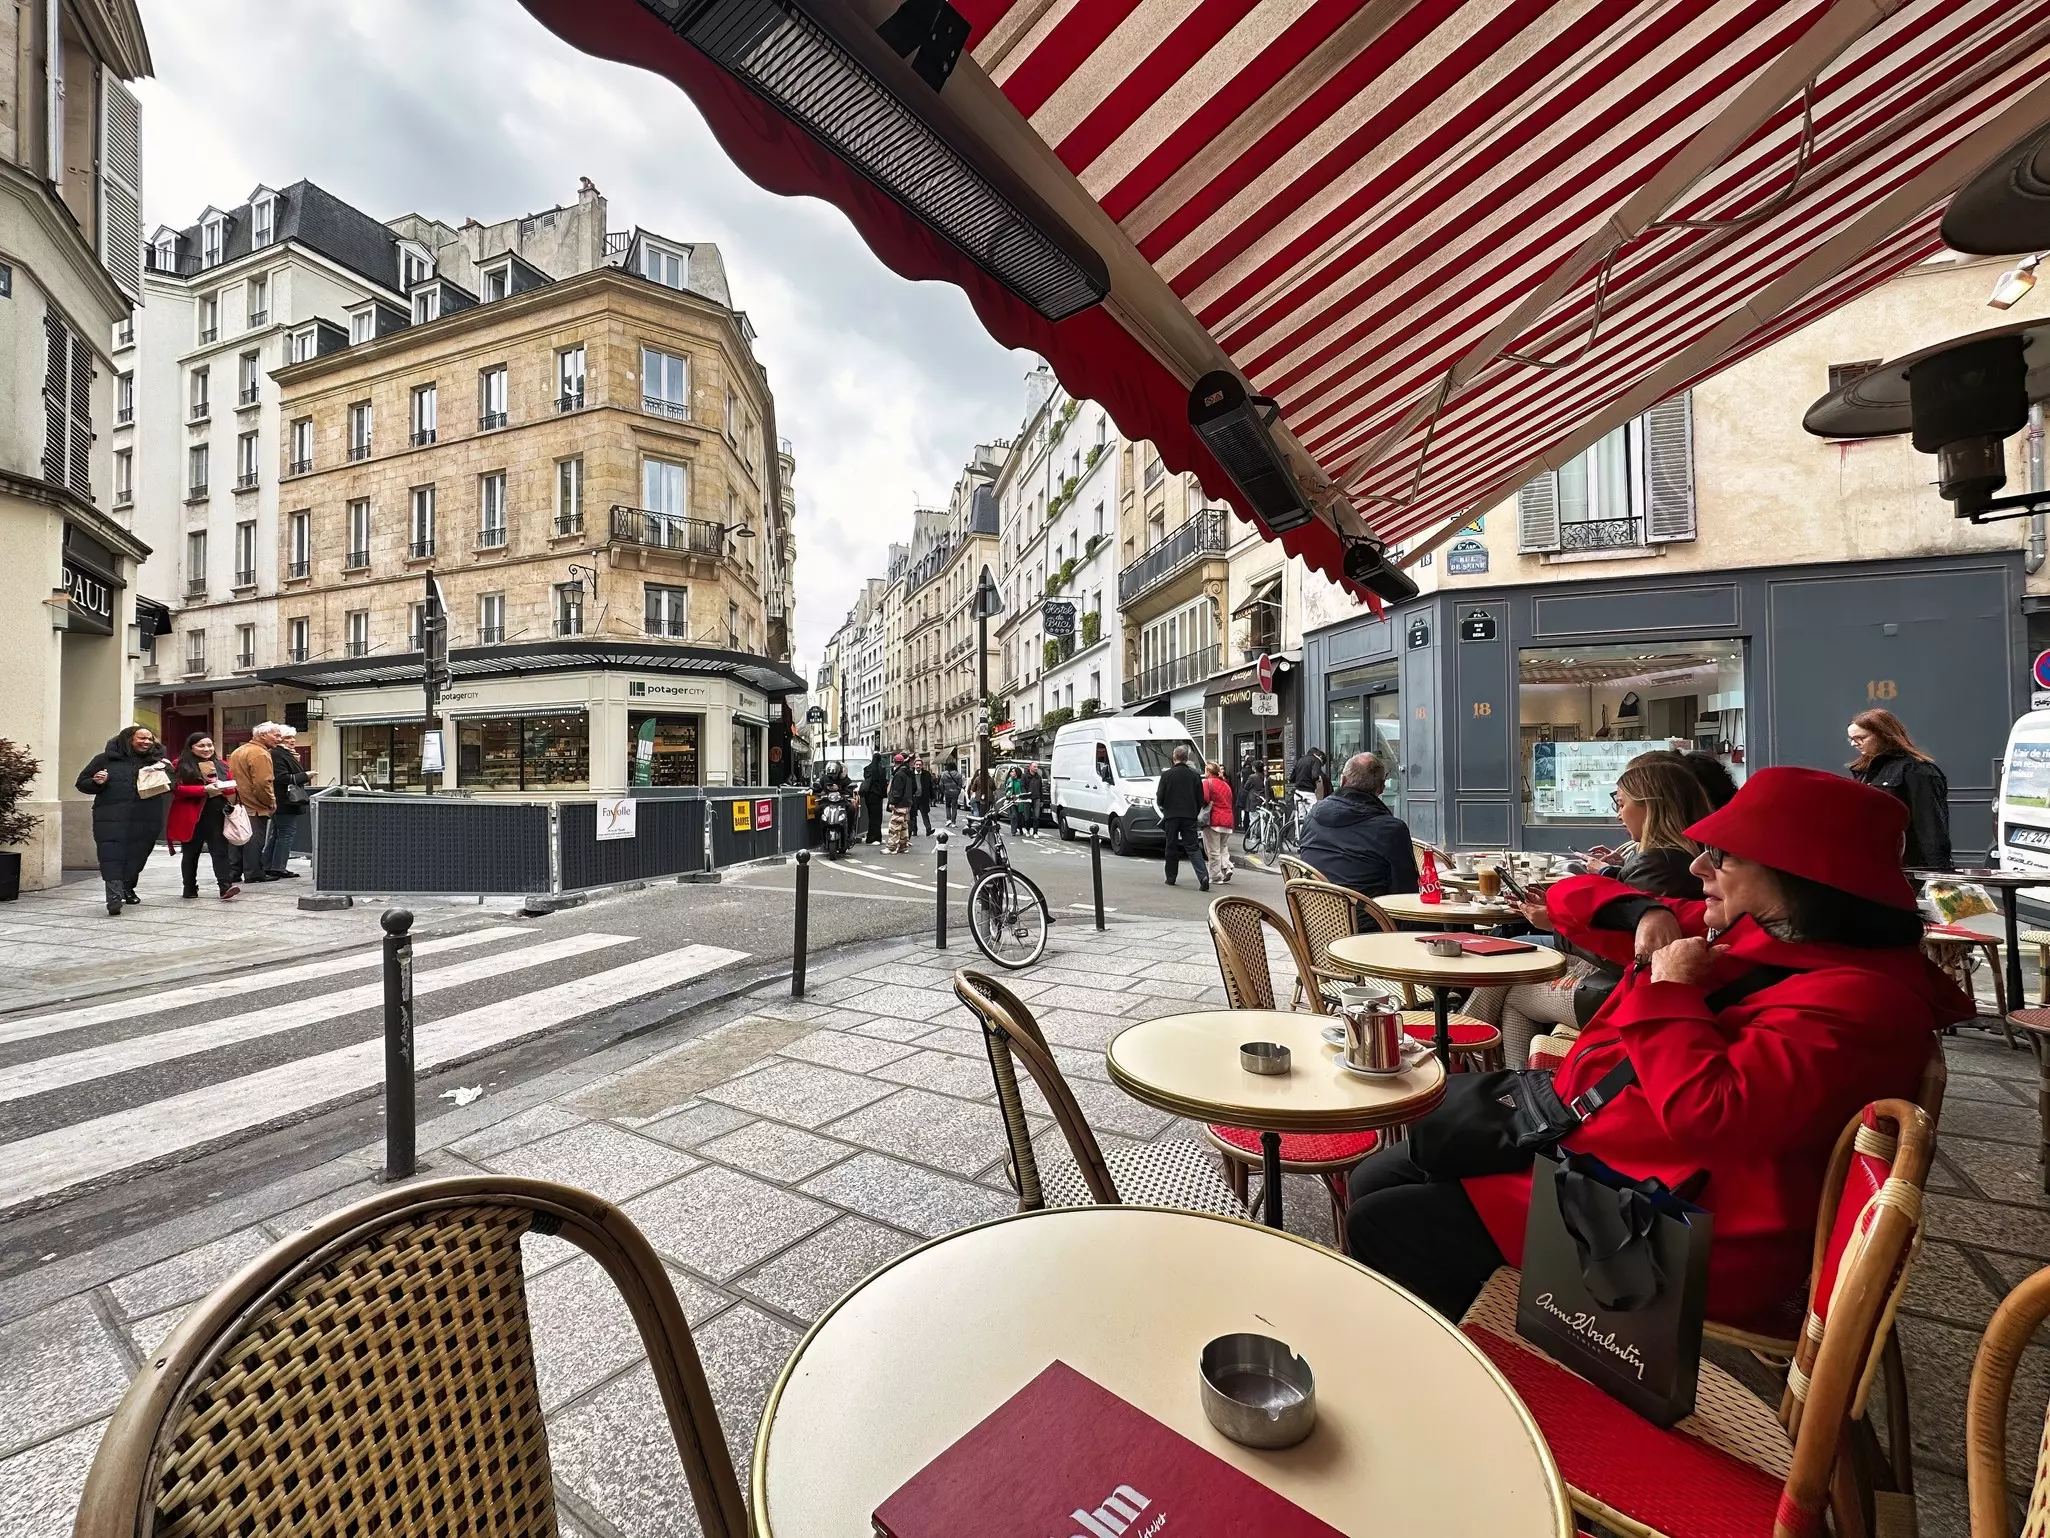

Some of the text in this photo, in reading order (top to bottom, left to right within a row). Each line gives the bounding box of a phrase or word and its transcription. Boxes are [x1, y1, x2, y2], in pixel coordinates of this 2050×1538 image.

[1421, 554, 1431, 567] 18
[1462, 562, 1485, 570] SEINE
[62, 566, 110, 617] PAUL
[1220, 690, 1251, 705] PASTAVINO
[1866, 680, 1897, 700] 18
[1473, 702, 1491, 716] 18
[602, 803, 631, 825] Fayolle
